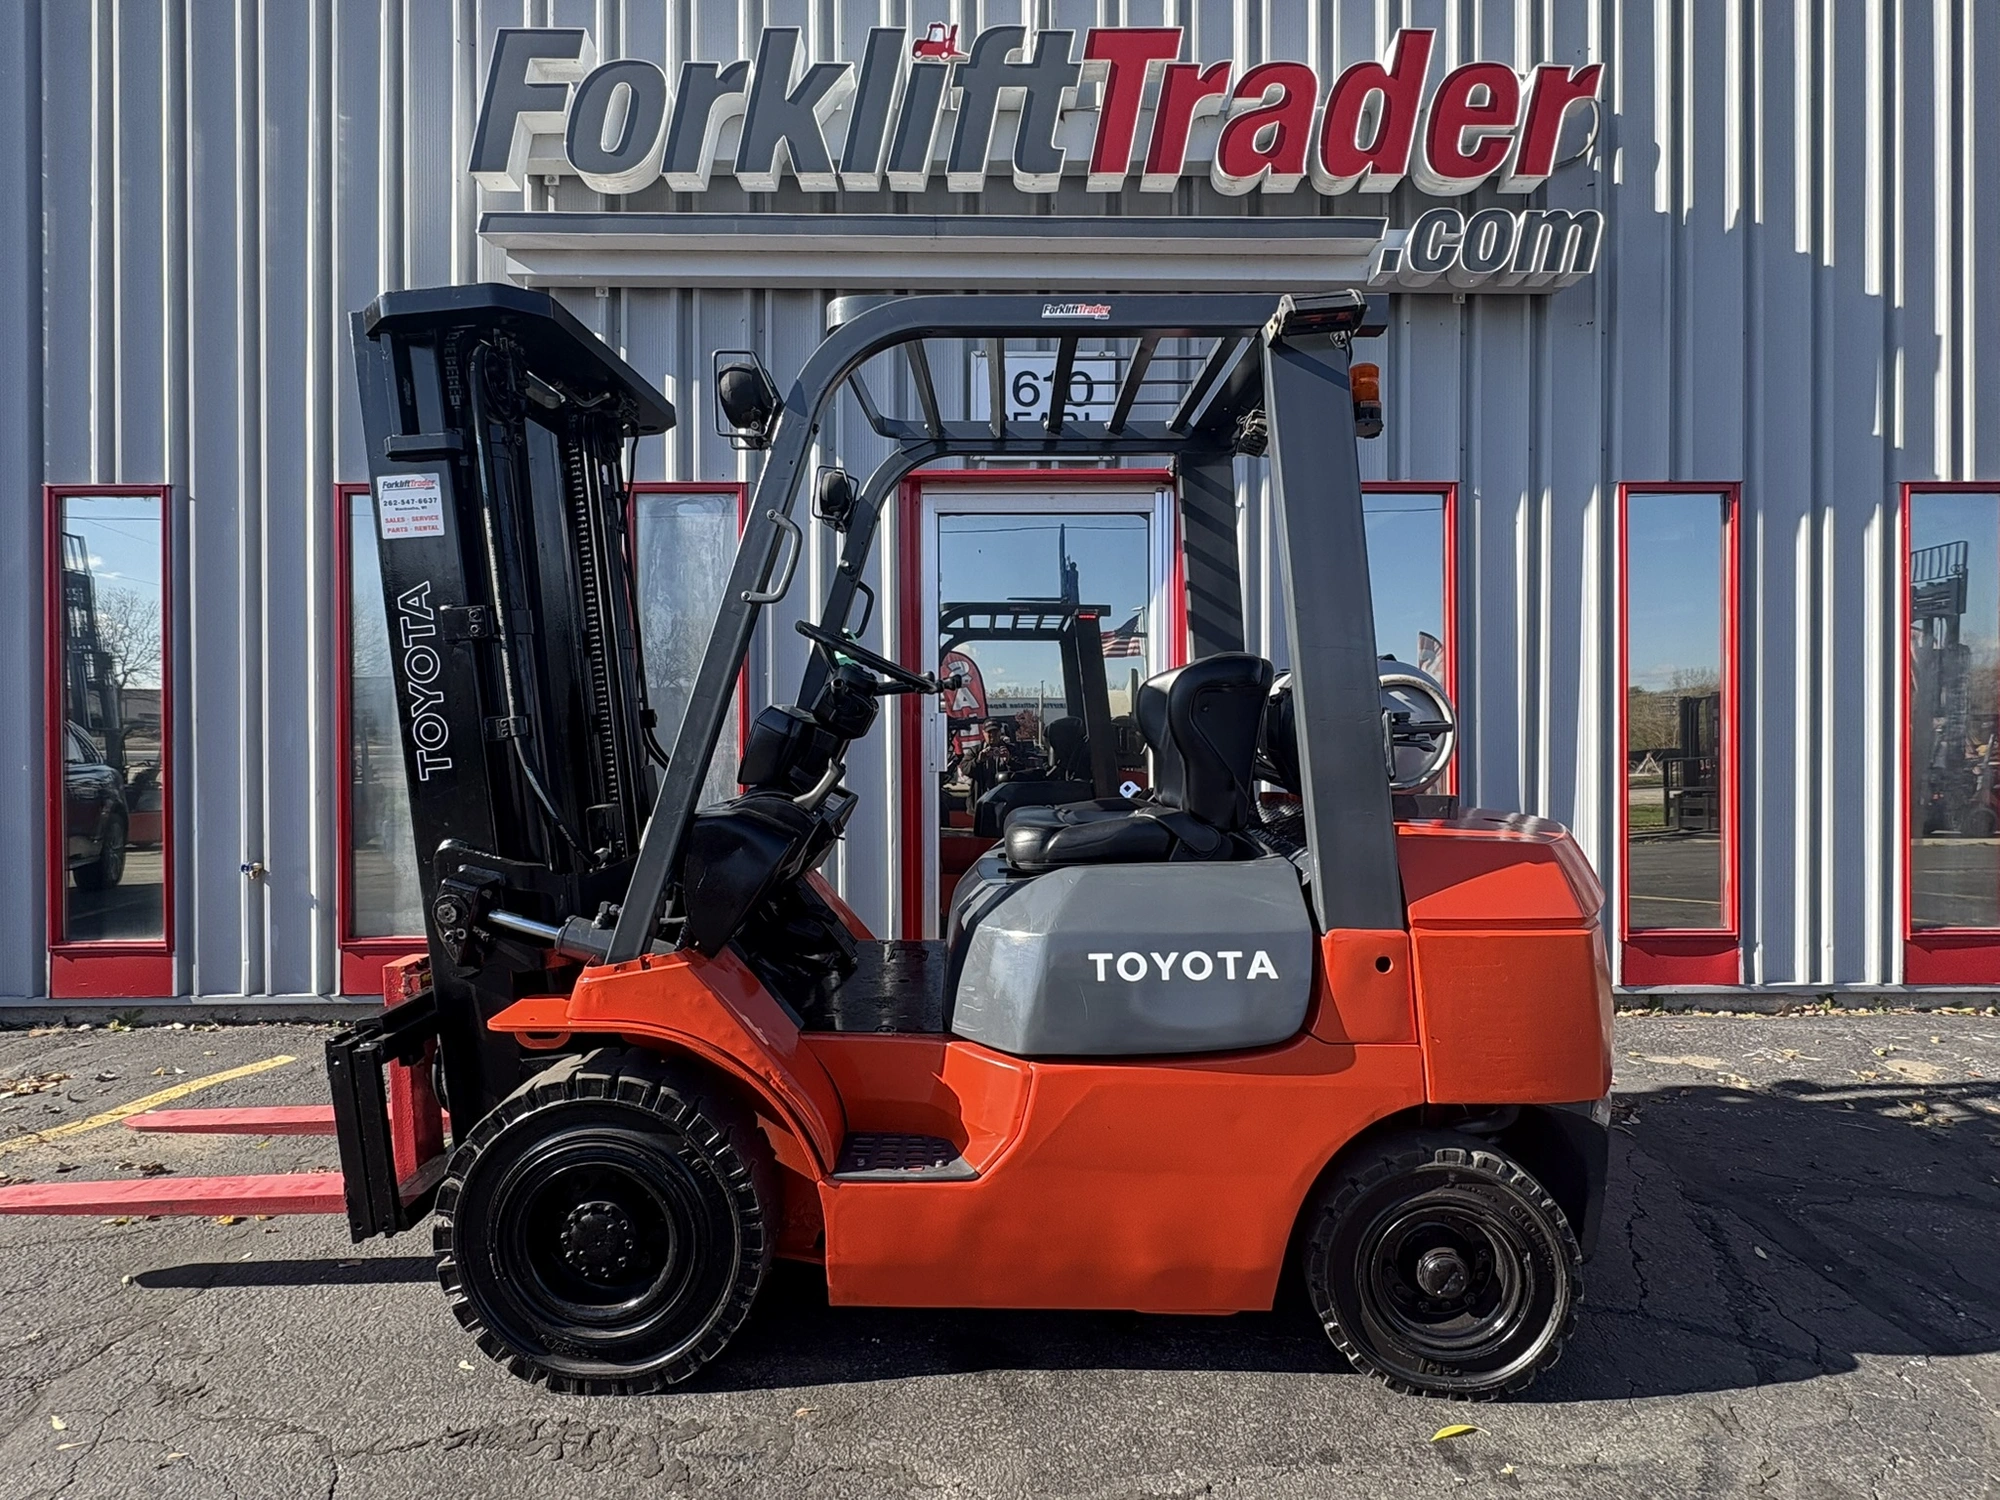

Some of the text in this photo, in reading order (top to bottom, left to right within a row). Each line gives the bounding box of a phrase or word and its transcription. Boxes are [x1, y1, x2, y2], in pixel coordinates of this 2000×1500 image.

[467, 26, 1604, 180] ForkliftTrader
[1378, 206, 1605, 275] .com
[411, 514, 439, 523] SERVICE
[397, 580, 452, 782] TOYOTA
[1087, 950, 1279, 982] TOYOTA
